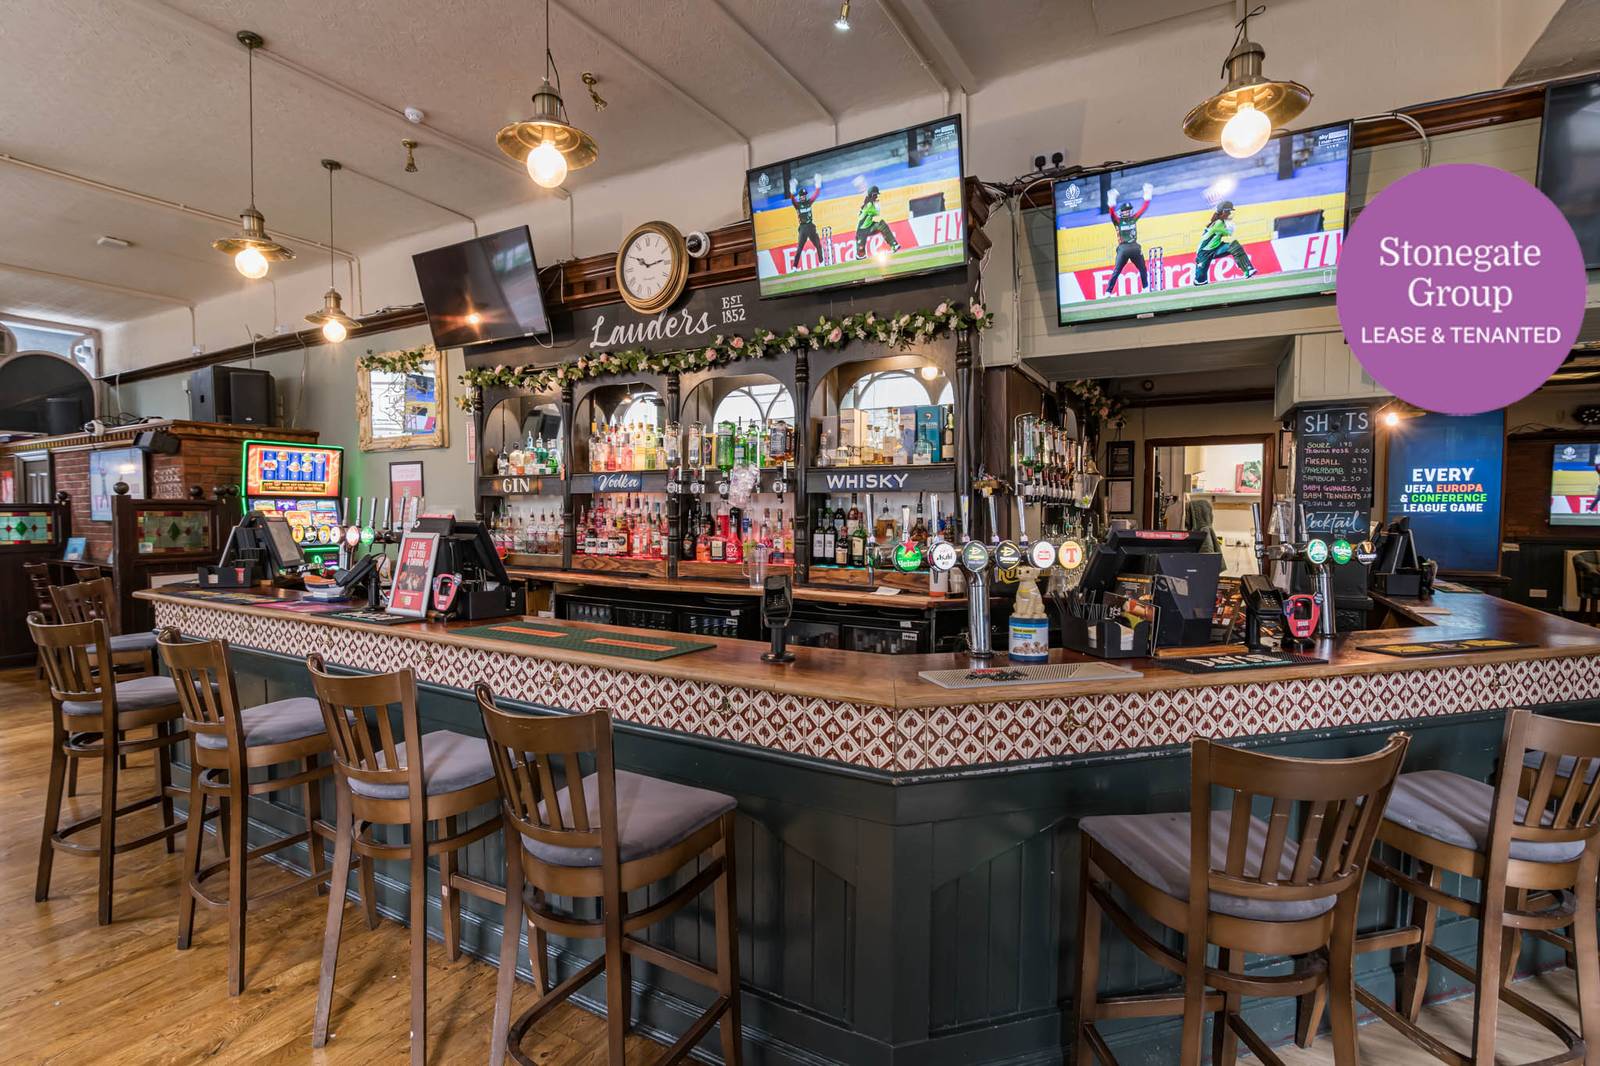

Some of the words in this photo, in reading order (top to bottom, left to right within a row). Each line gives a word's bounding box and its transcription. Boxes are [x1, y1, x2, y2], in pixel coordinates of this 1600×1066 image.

[721, 294, 743, 309] EST
[722, 308, 746, 324] 1852
[589, 308, 717, 348] Lauders
[1304, 412, 1369, 433] SHTS
[1304, 457, 1341, 465] FIREBALL
[826, 473, 909, 489] WHISKY
[1412, 467, 1475, 482] EVERY
[502, 477, 530, 493] GIN
[598, 473, 639, 491] Vodka
[1404, 484, 1433, 493] UEFA
[1436, 483, 1483, 493] EUROPA
[1400, 494, 1409, 503] &
[1411, 493, 1488, 503] CONFERENCE
[1403, 503, 1447, 513] LEAGUE
[1449, 503, 1484, 513] GAME
[1305, 510, 1364, 534] Cocktail
